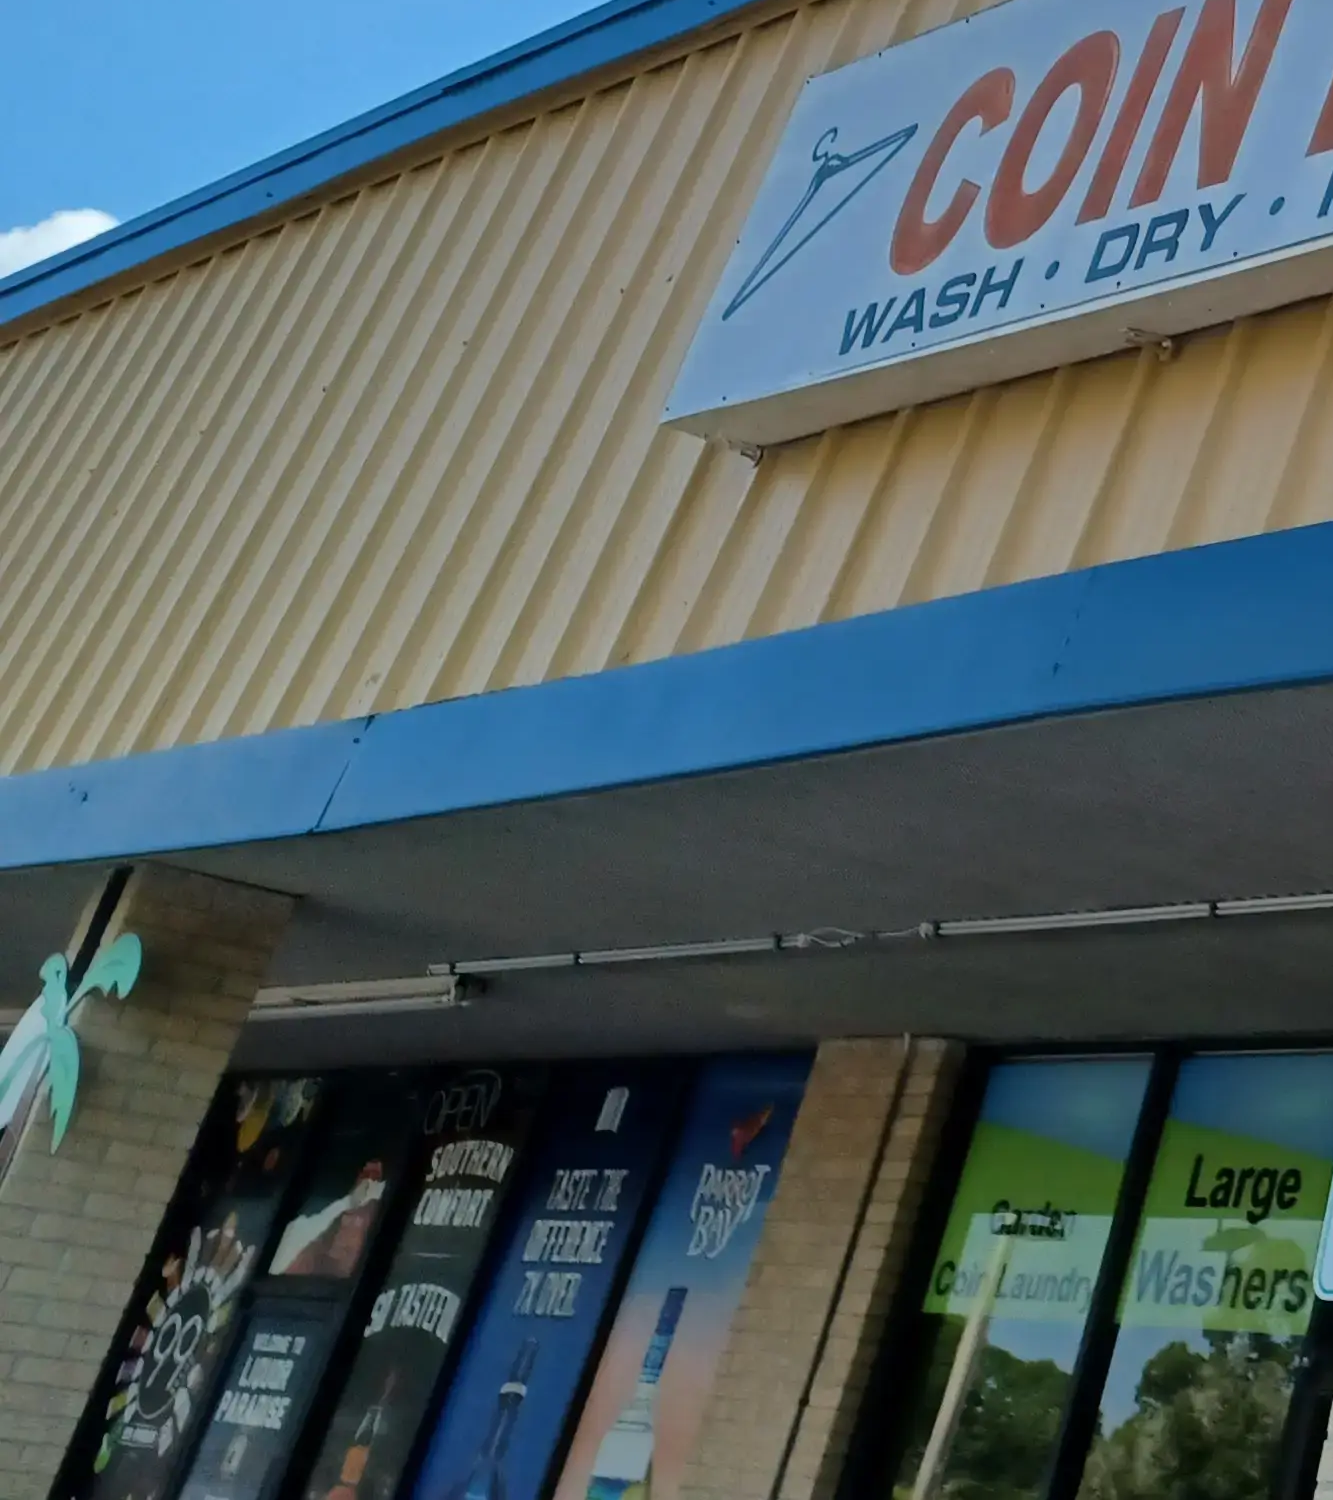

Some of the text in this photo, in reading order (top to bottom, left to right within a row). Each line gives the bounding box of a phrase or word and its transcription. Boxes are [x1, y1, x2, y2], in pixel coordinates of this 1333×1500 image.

[838, 257, 1025, 355] WASH
[1083, 192, 1245, 285] DRY
[425, 1139, 514, 1185] SOUTHERN
[546, 1168, 599, 1212] TASTE
[1185, 1153, 1302, 1225] Large
[413, 1188, 495, 1228] COMFORT
[690, 1163, 772, 1224] PARROT
[686, 1205, 745, 1259] BAY
[1137, 1249, 1309, 1314] Washers
[145, 1313, 203, 1390] 99
